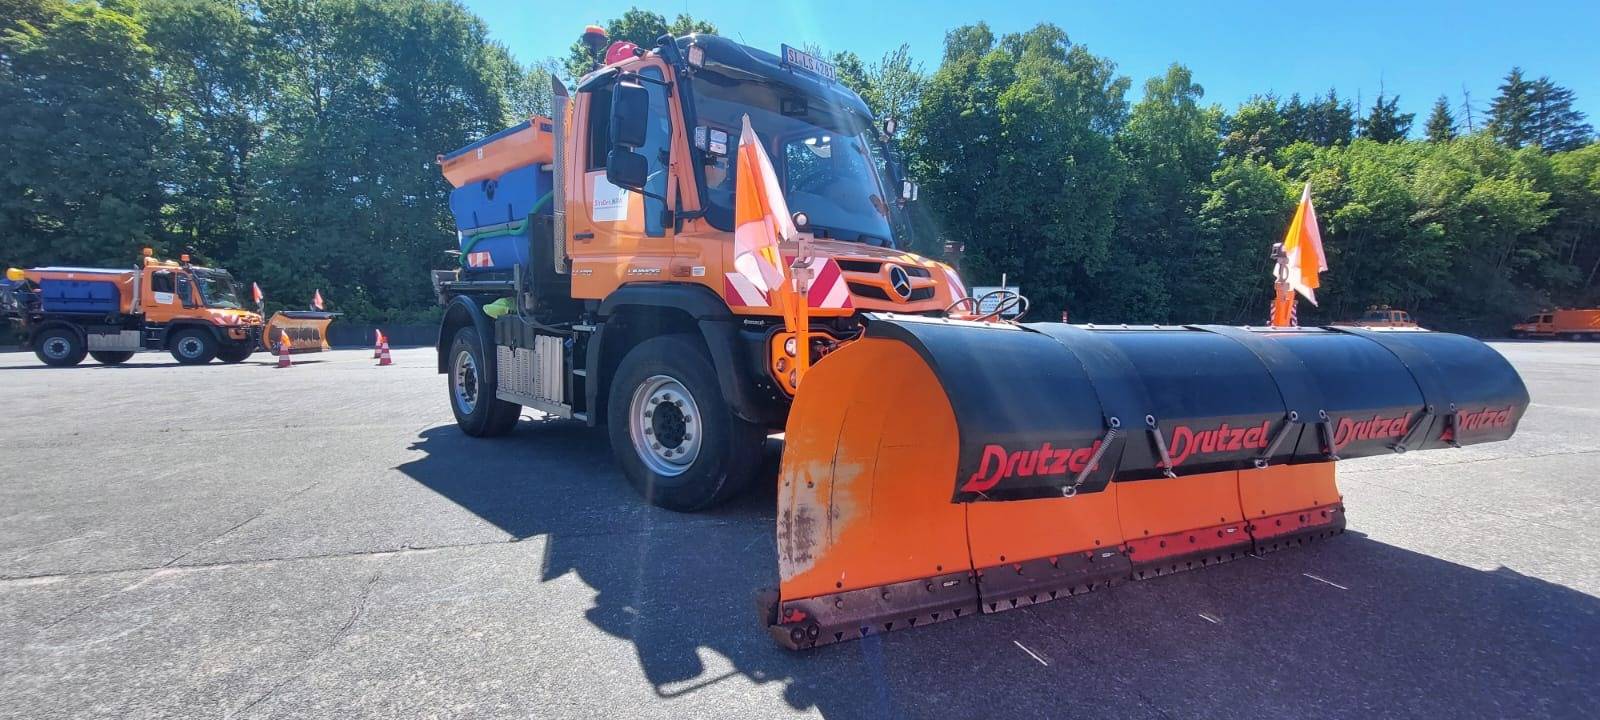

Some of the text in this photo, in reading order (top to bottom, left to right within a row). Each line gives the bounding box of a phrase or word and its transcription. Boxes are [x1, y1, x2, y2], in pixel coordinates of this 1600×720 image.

[789, 49, 798, 64] SI
[1156, 421, 1270, 468] Drutzel
[1322, 410, 1412, 453] Drutzel
